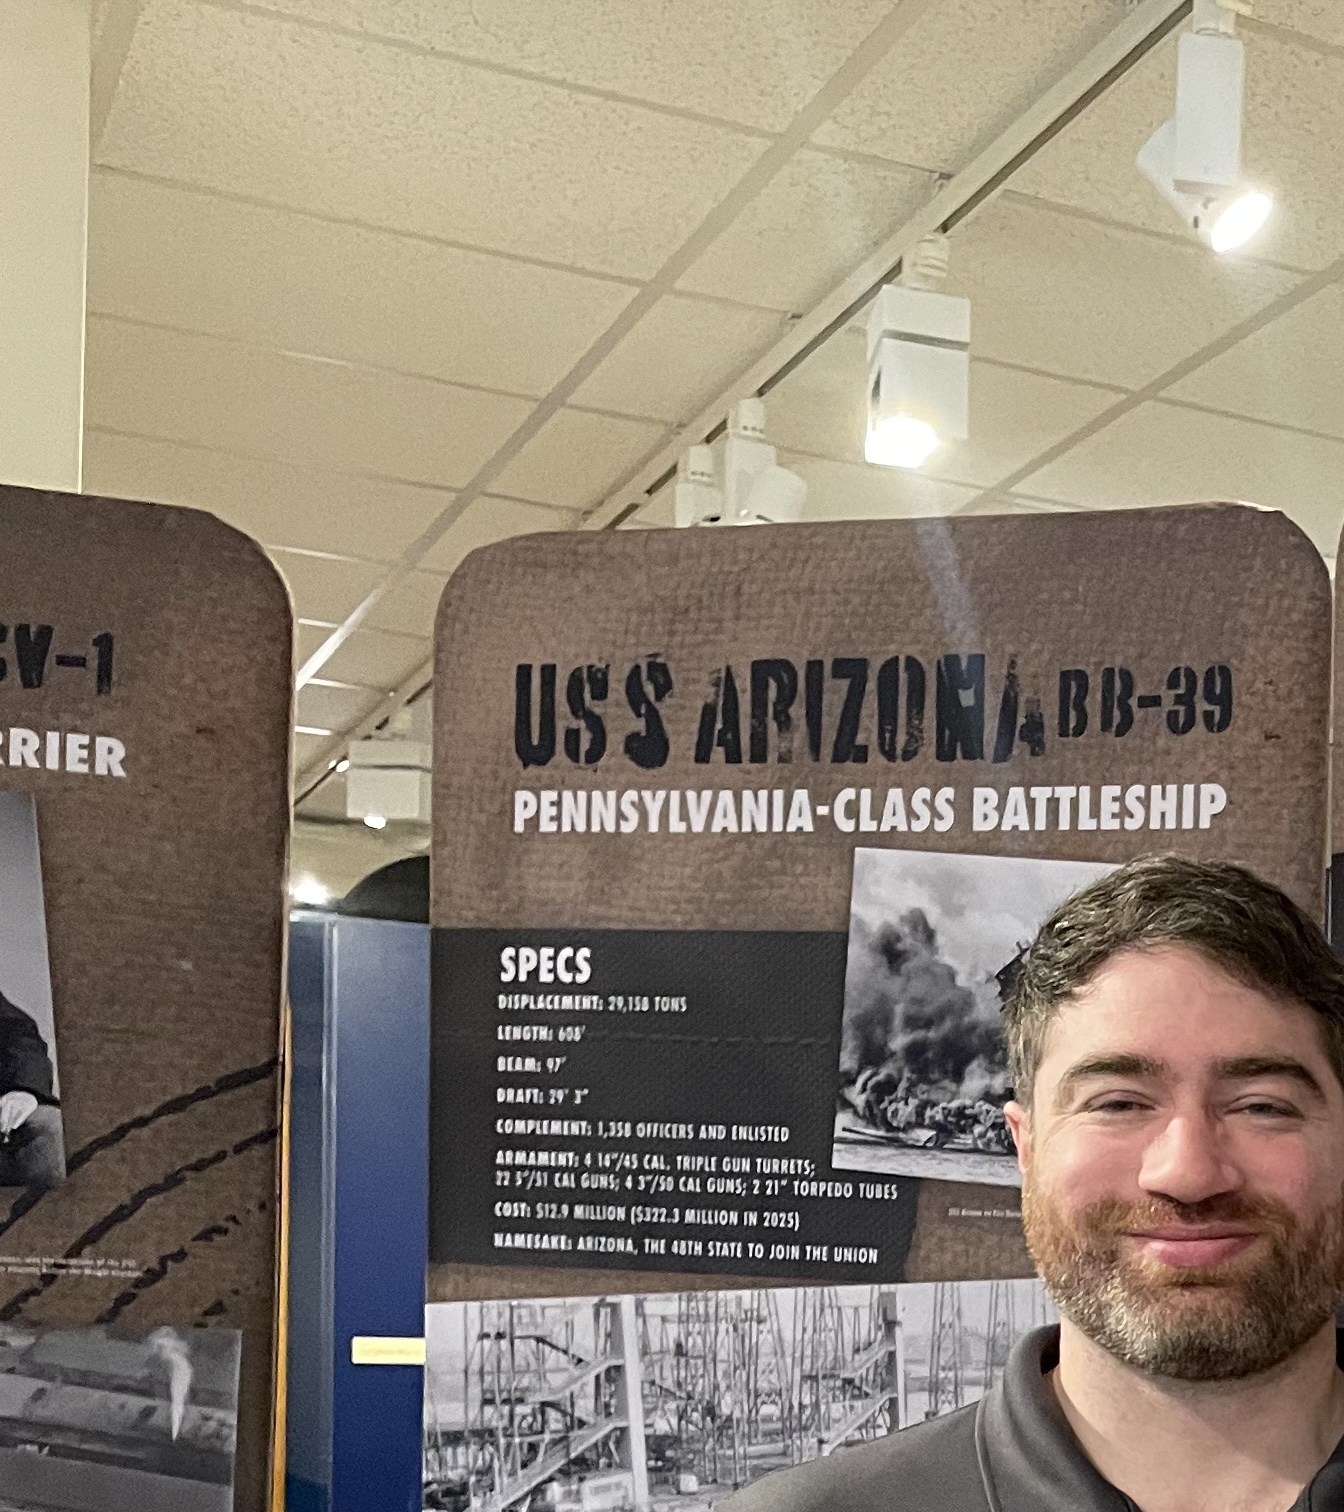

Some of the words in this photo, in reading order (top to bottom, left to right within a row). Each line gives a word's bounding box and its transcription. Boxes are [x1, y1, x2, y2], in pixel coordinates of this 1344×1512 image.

[0, 623, 113, 695] V-1
[514, 653, 672, 770] USS
[694, 653, 1046, 764] ARIZONA
[1058, 665, 1234, 739] BB-39
[0, 727, 127, 777] RIER
[513, 786, 955, 834] PENNSYLVANIA-CLASS
[972, 783, 1227, 832] BATTLESHIP
[500, 946, 591, 984] SPECS
[643, 1237, 666, 1255] THE
[671, 1239, 703, 1256] 48TH
[707, 1240, 742, 1259] STATE
[747, 1242, 764, 1259] TO
[768, 1243, 800, 1261] JOIN
[805, 1244, 828, 1262] THE
[833, 1246, 878, 1264] UNION
